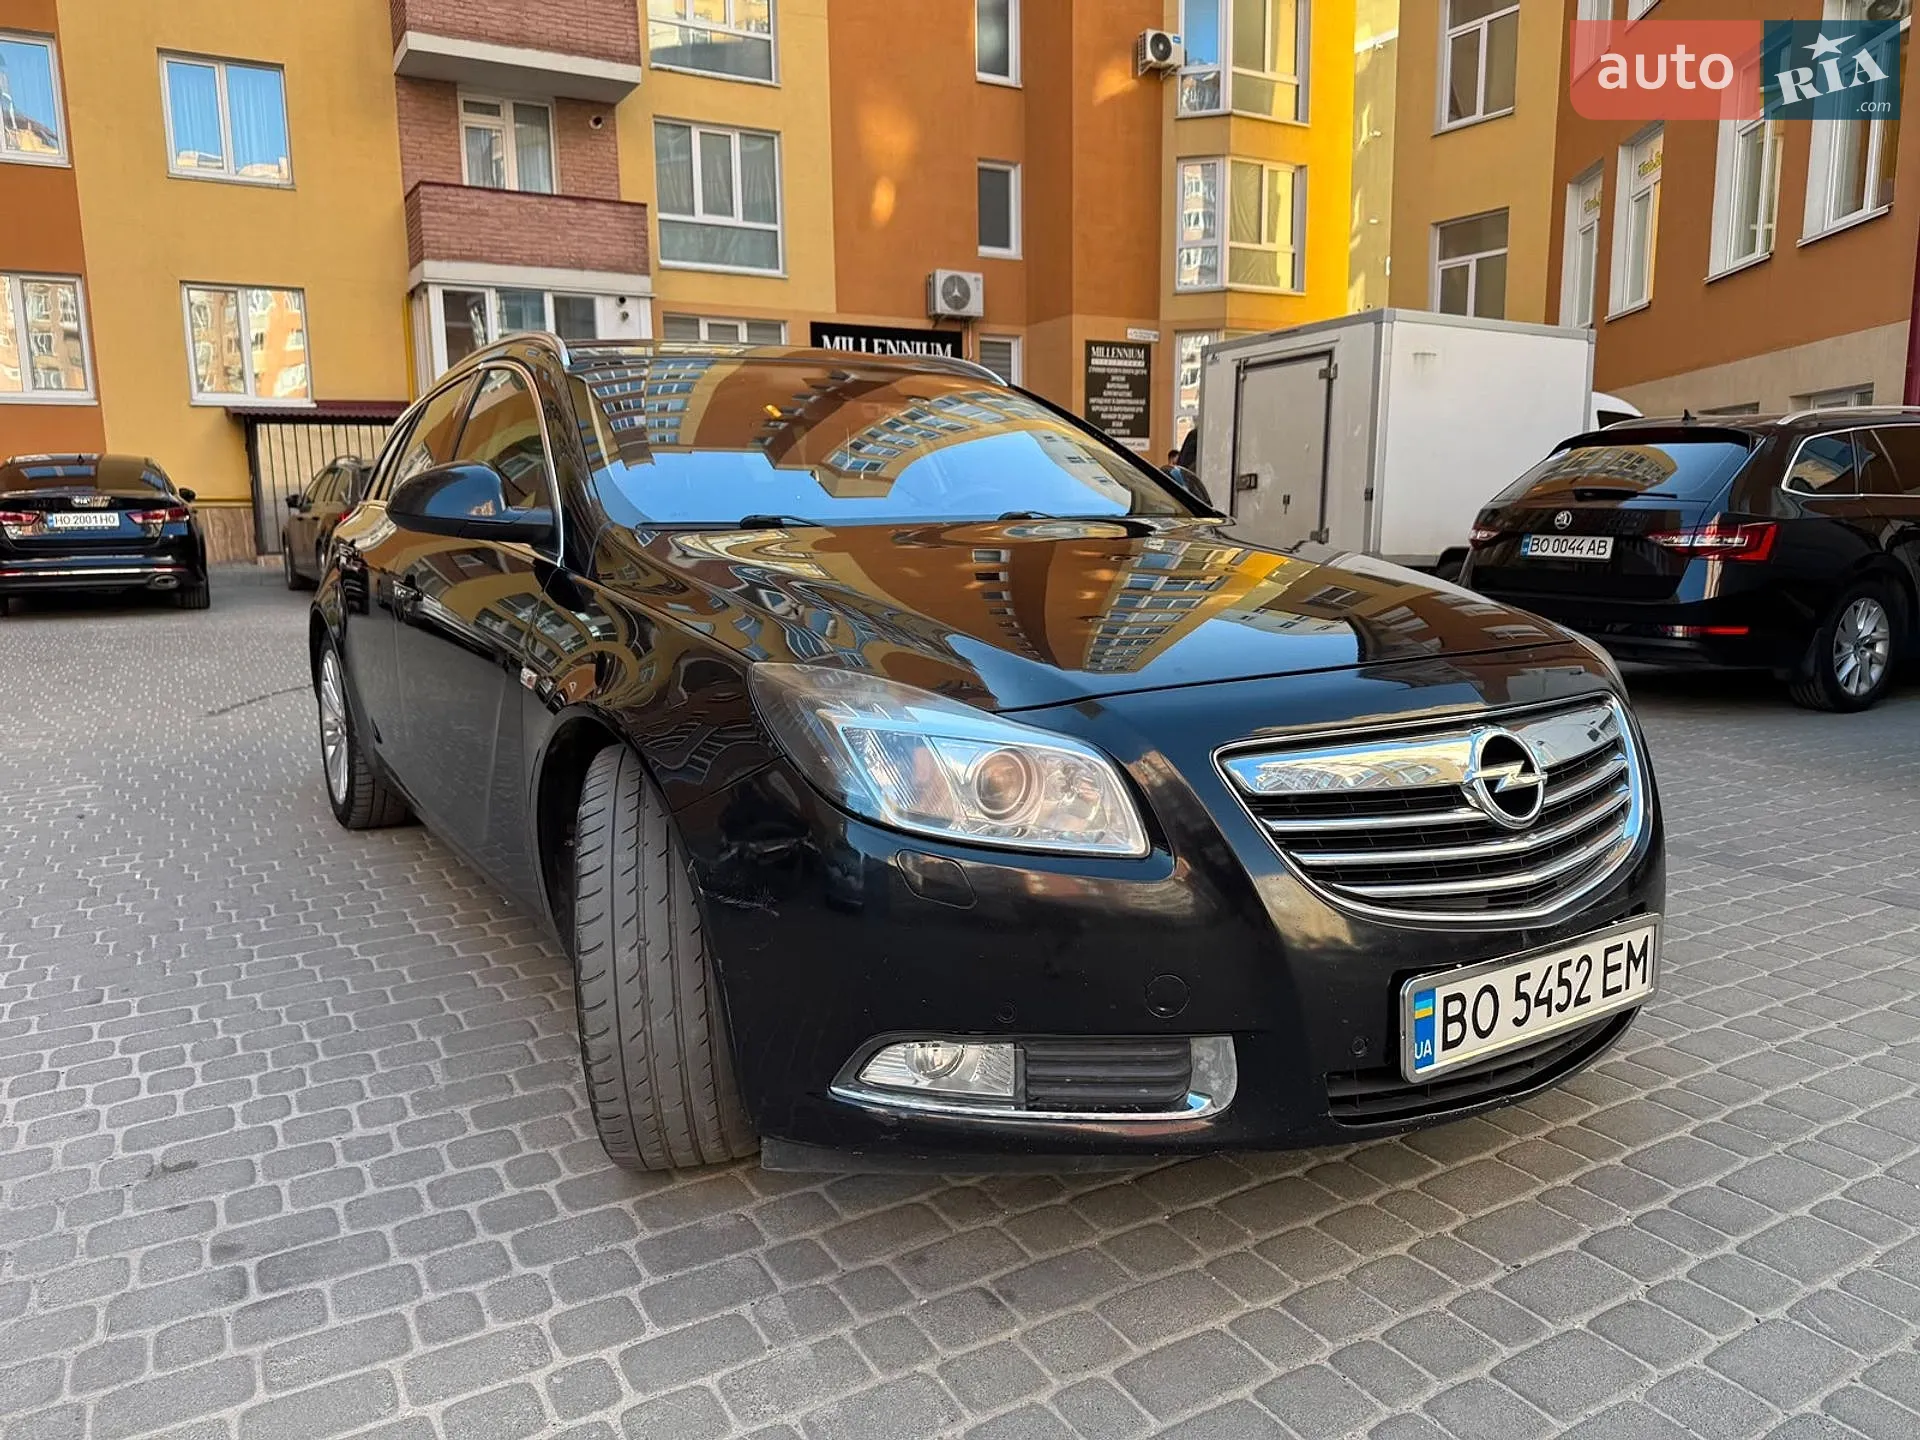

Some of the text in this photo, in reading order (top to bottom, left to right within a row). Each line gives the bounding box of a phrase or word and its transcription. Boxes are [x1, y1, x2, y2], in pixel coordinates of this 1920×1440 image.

[821, 334, 952, 358] MILLENNIUM
[1091, 345, 1145, 360] MILLENNIUM
[1530, 537, 1608, 556] BO 0044 AB
[1442, 934, 1649, 1051] BO 5452 EM
[1414, 1040, 1432, 1059] UA
